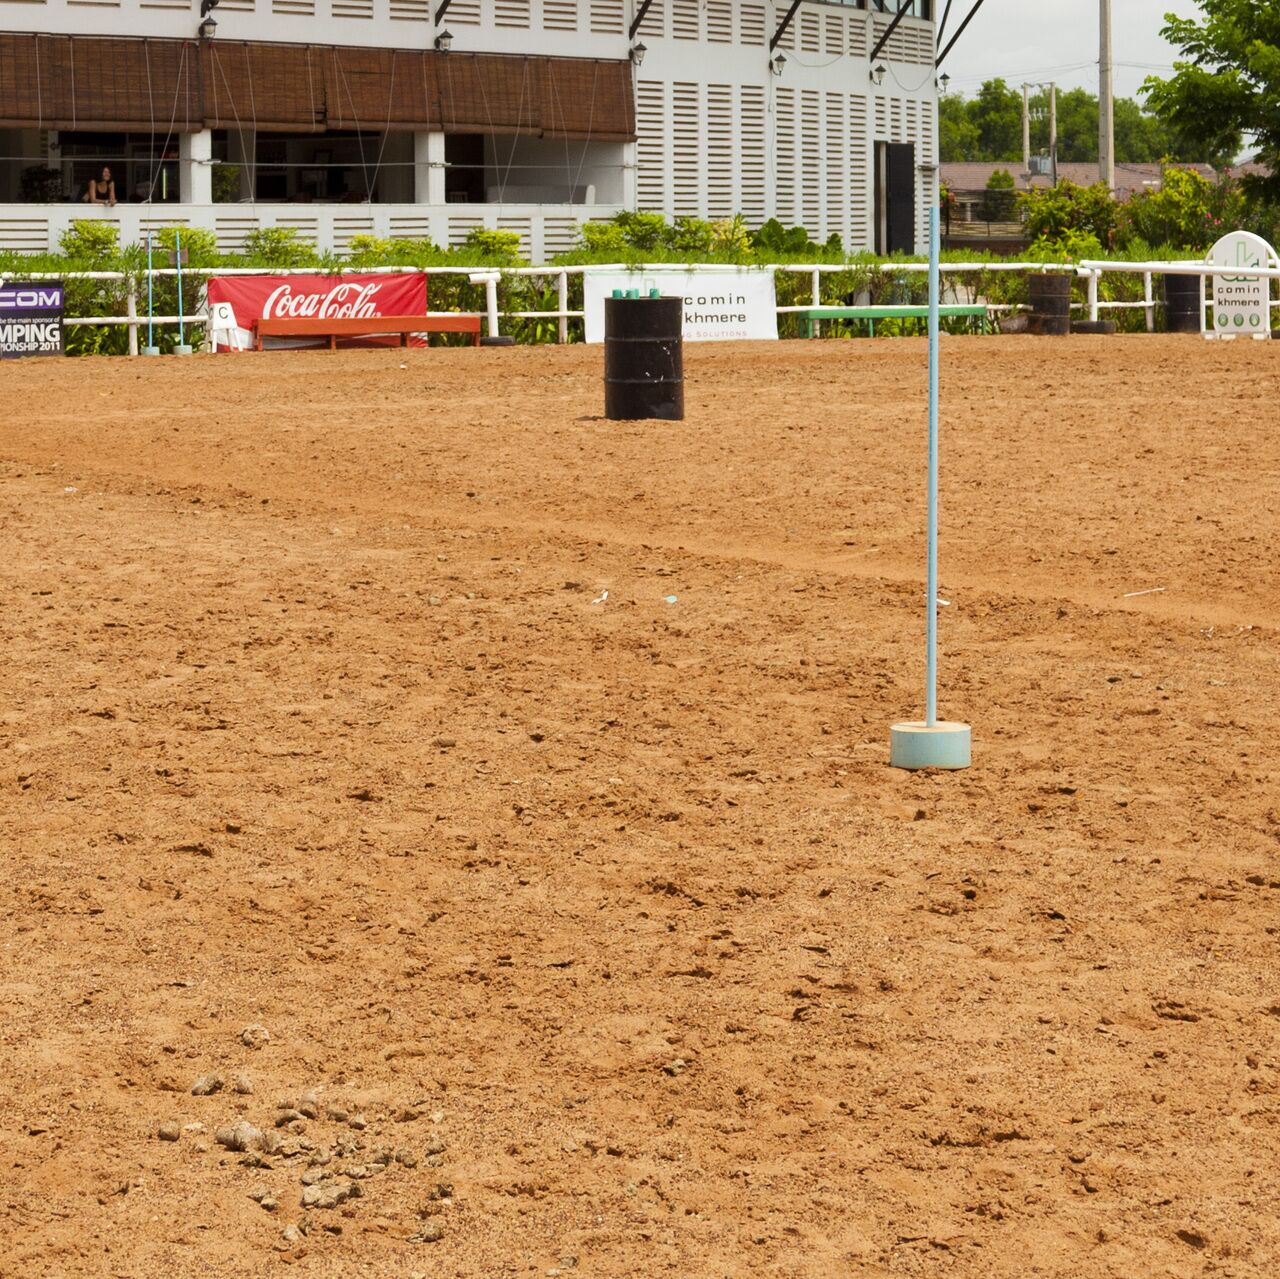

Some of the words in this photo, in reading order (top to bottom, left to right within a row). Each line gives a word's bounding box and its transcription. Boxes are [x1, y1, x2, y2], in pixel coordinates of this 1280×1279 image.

[1217, 284, 1260, 294] comin
[263, 282, 383, 320] Coca-Cola
[684, 293, 746, 305] comin
[1217, 298, 1260, 307] khmere
[218, 306, 229, 319] C
[684, 312, 747, 323] khmere
[32, 317, 53, 325] sponsor
[39, 342, 60, 351] 2011
